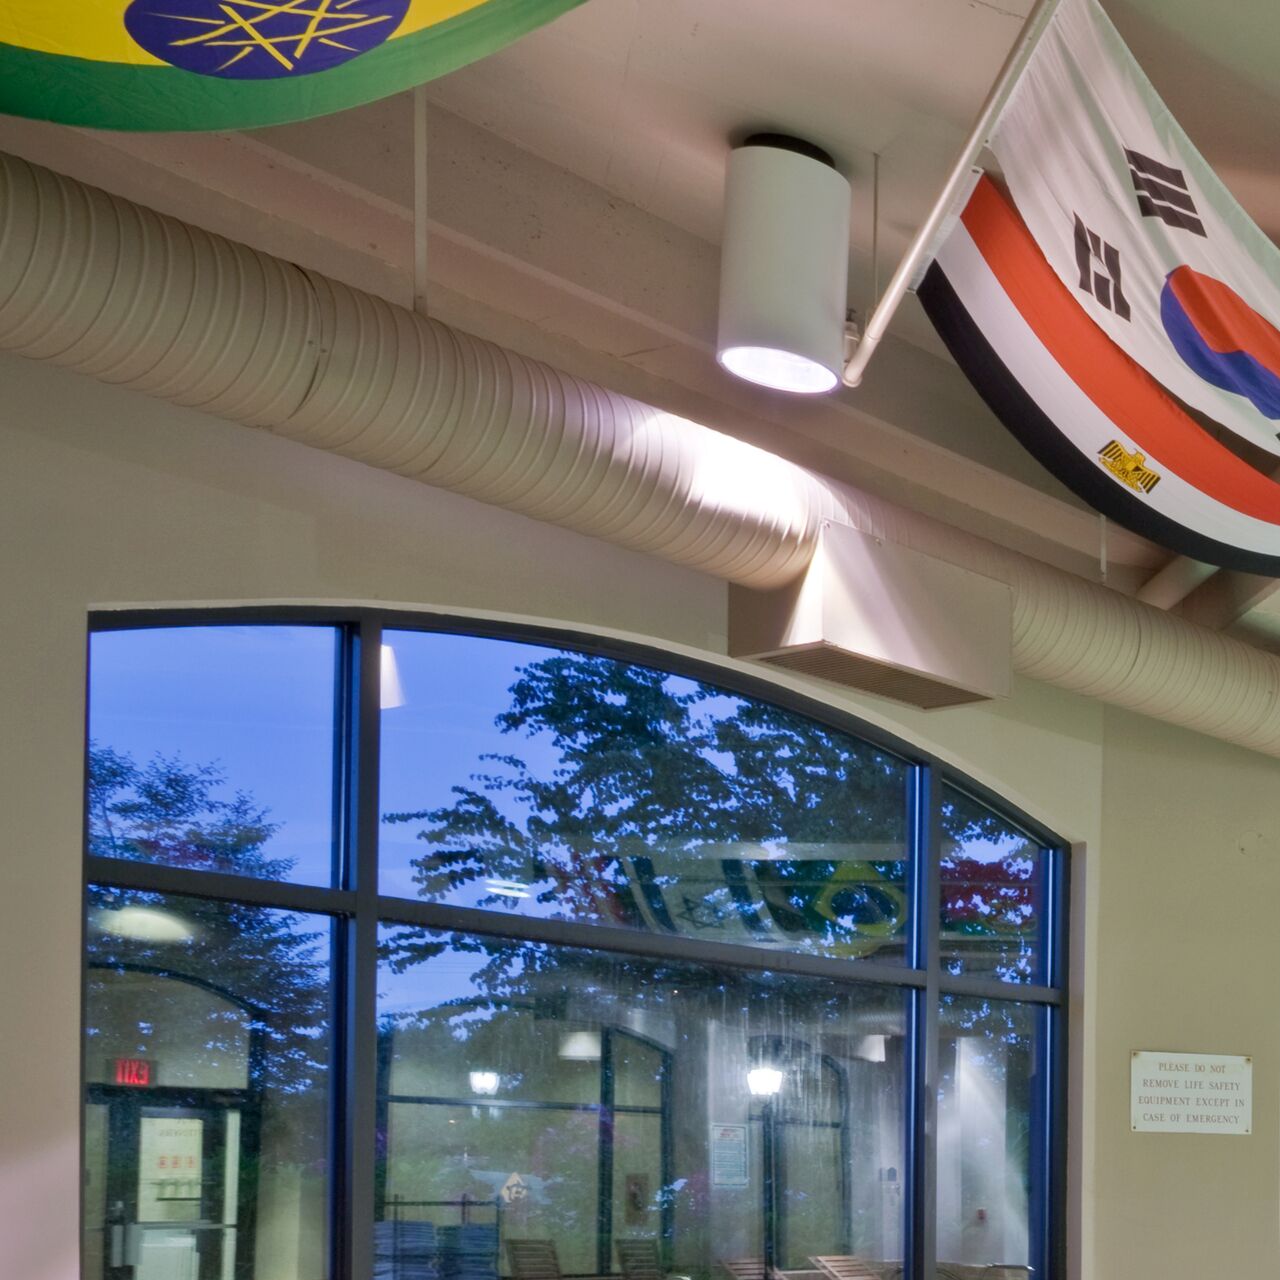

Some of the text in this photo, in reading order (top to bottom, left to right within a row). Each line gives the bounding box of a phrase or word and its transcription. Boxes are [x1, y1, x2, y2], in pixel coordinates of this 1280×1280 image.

[1158, 1062, 1227, 1074] PLEASE DO NOT
[1142, 1079, 1241, 1091] REMOVE LIFE SAFETY
[1138, 1096, 1245, 1107] EQUIPMENT EXCEPT IN
[1143, 1112, 1240, 1124] CASE OF EMERGENCY
